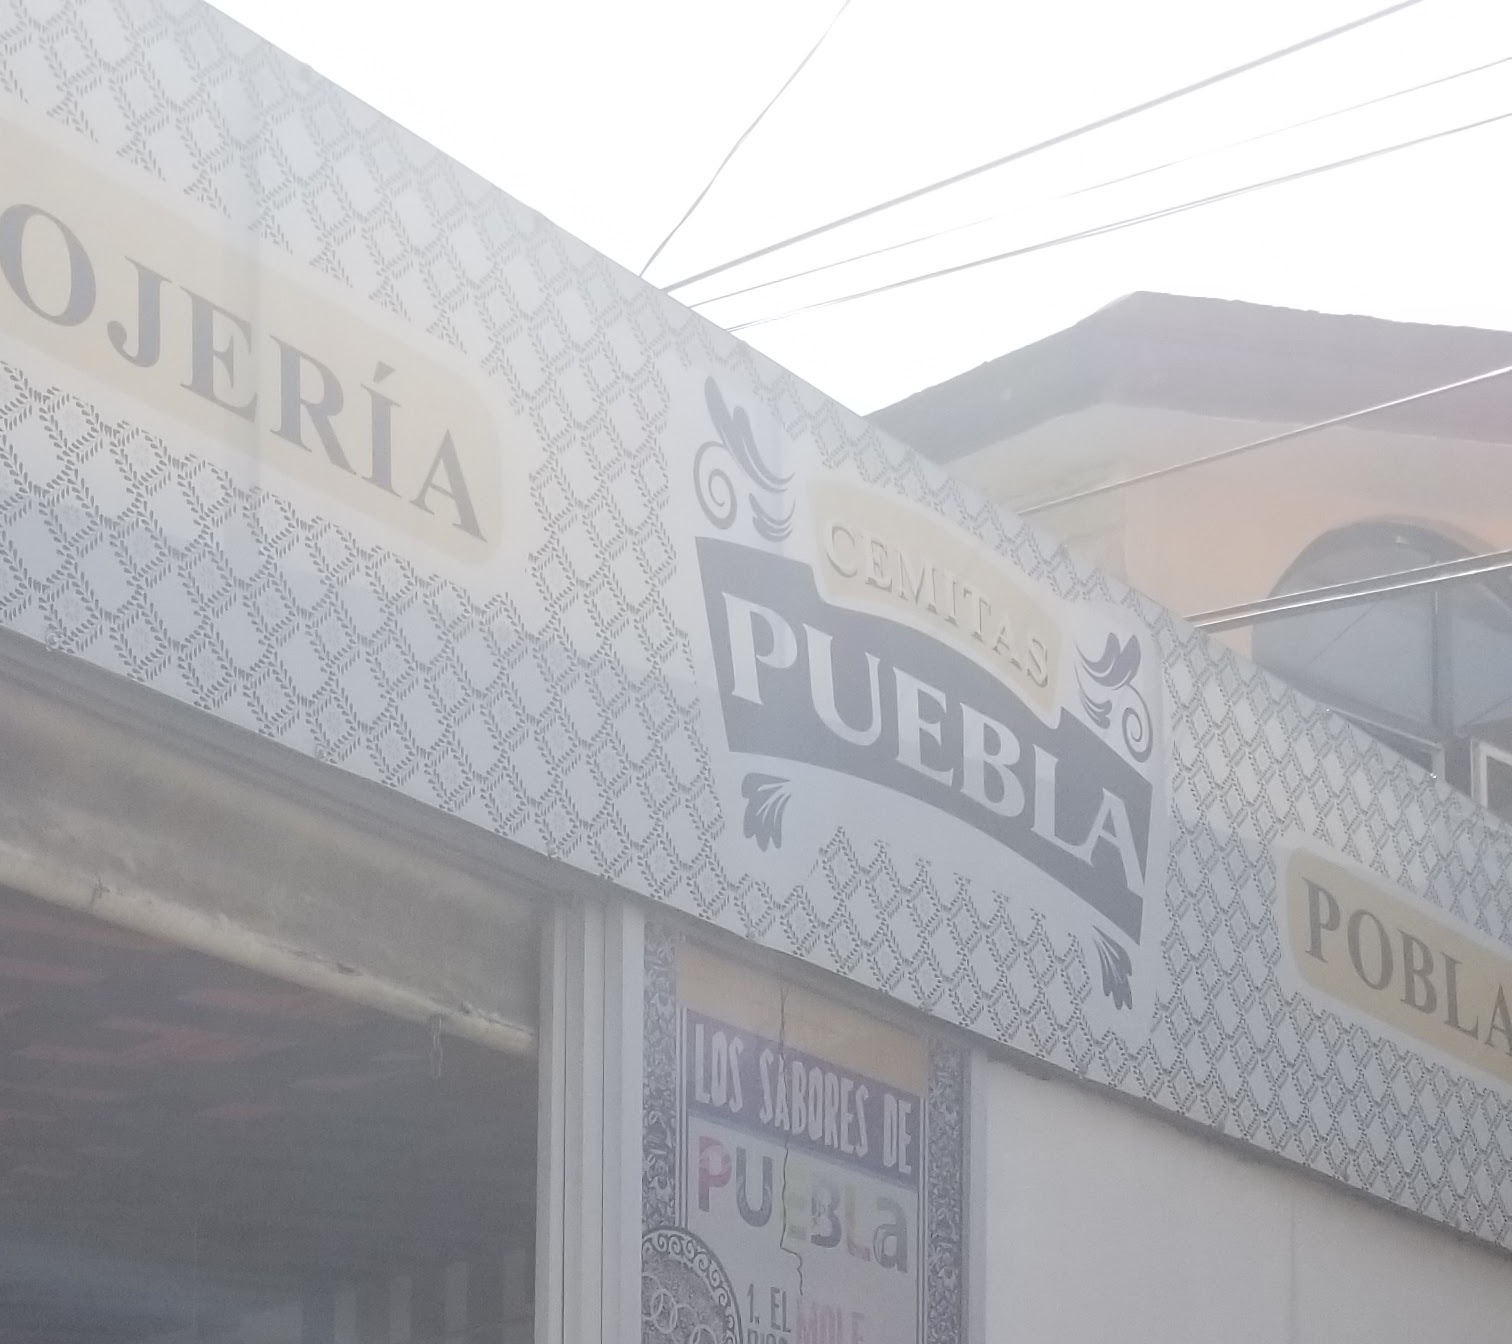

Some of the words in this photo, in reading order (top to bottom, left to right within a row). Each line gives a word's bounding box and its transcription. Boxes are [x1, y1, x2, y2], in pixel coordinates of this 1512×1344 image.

[825, 521, 1050, 689] CEMITAS
[721, 591, 1145, 894] PUEBLA
[694, 1022, 744, 1114] LOS
[758, 1047, 870, 1159] SABORES
[883, 1091, 912, 1175] DE
[747, 1282, 761, 1325] 1.
[770, 1286, 792, 1334] EL
